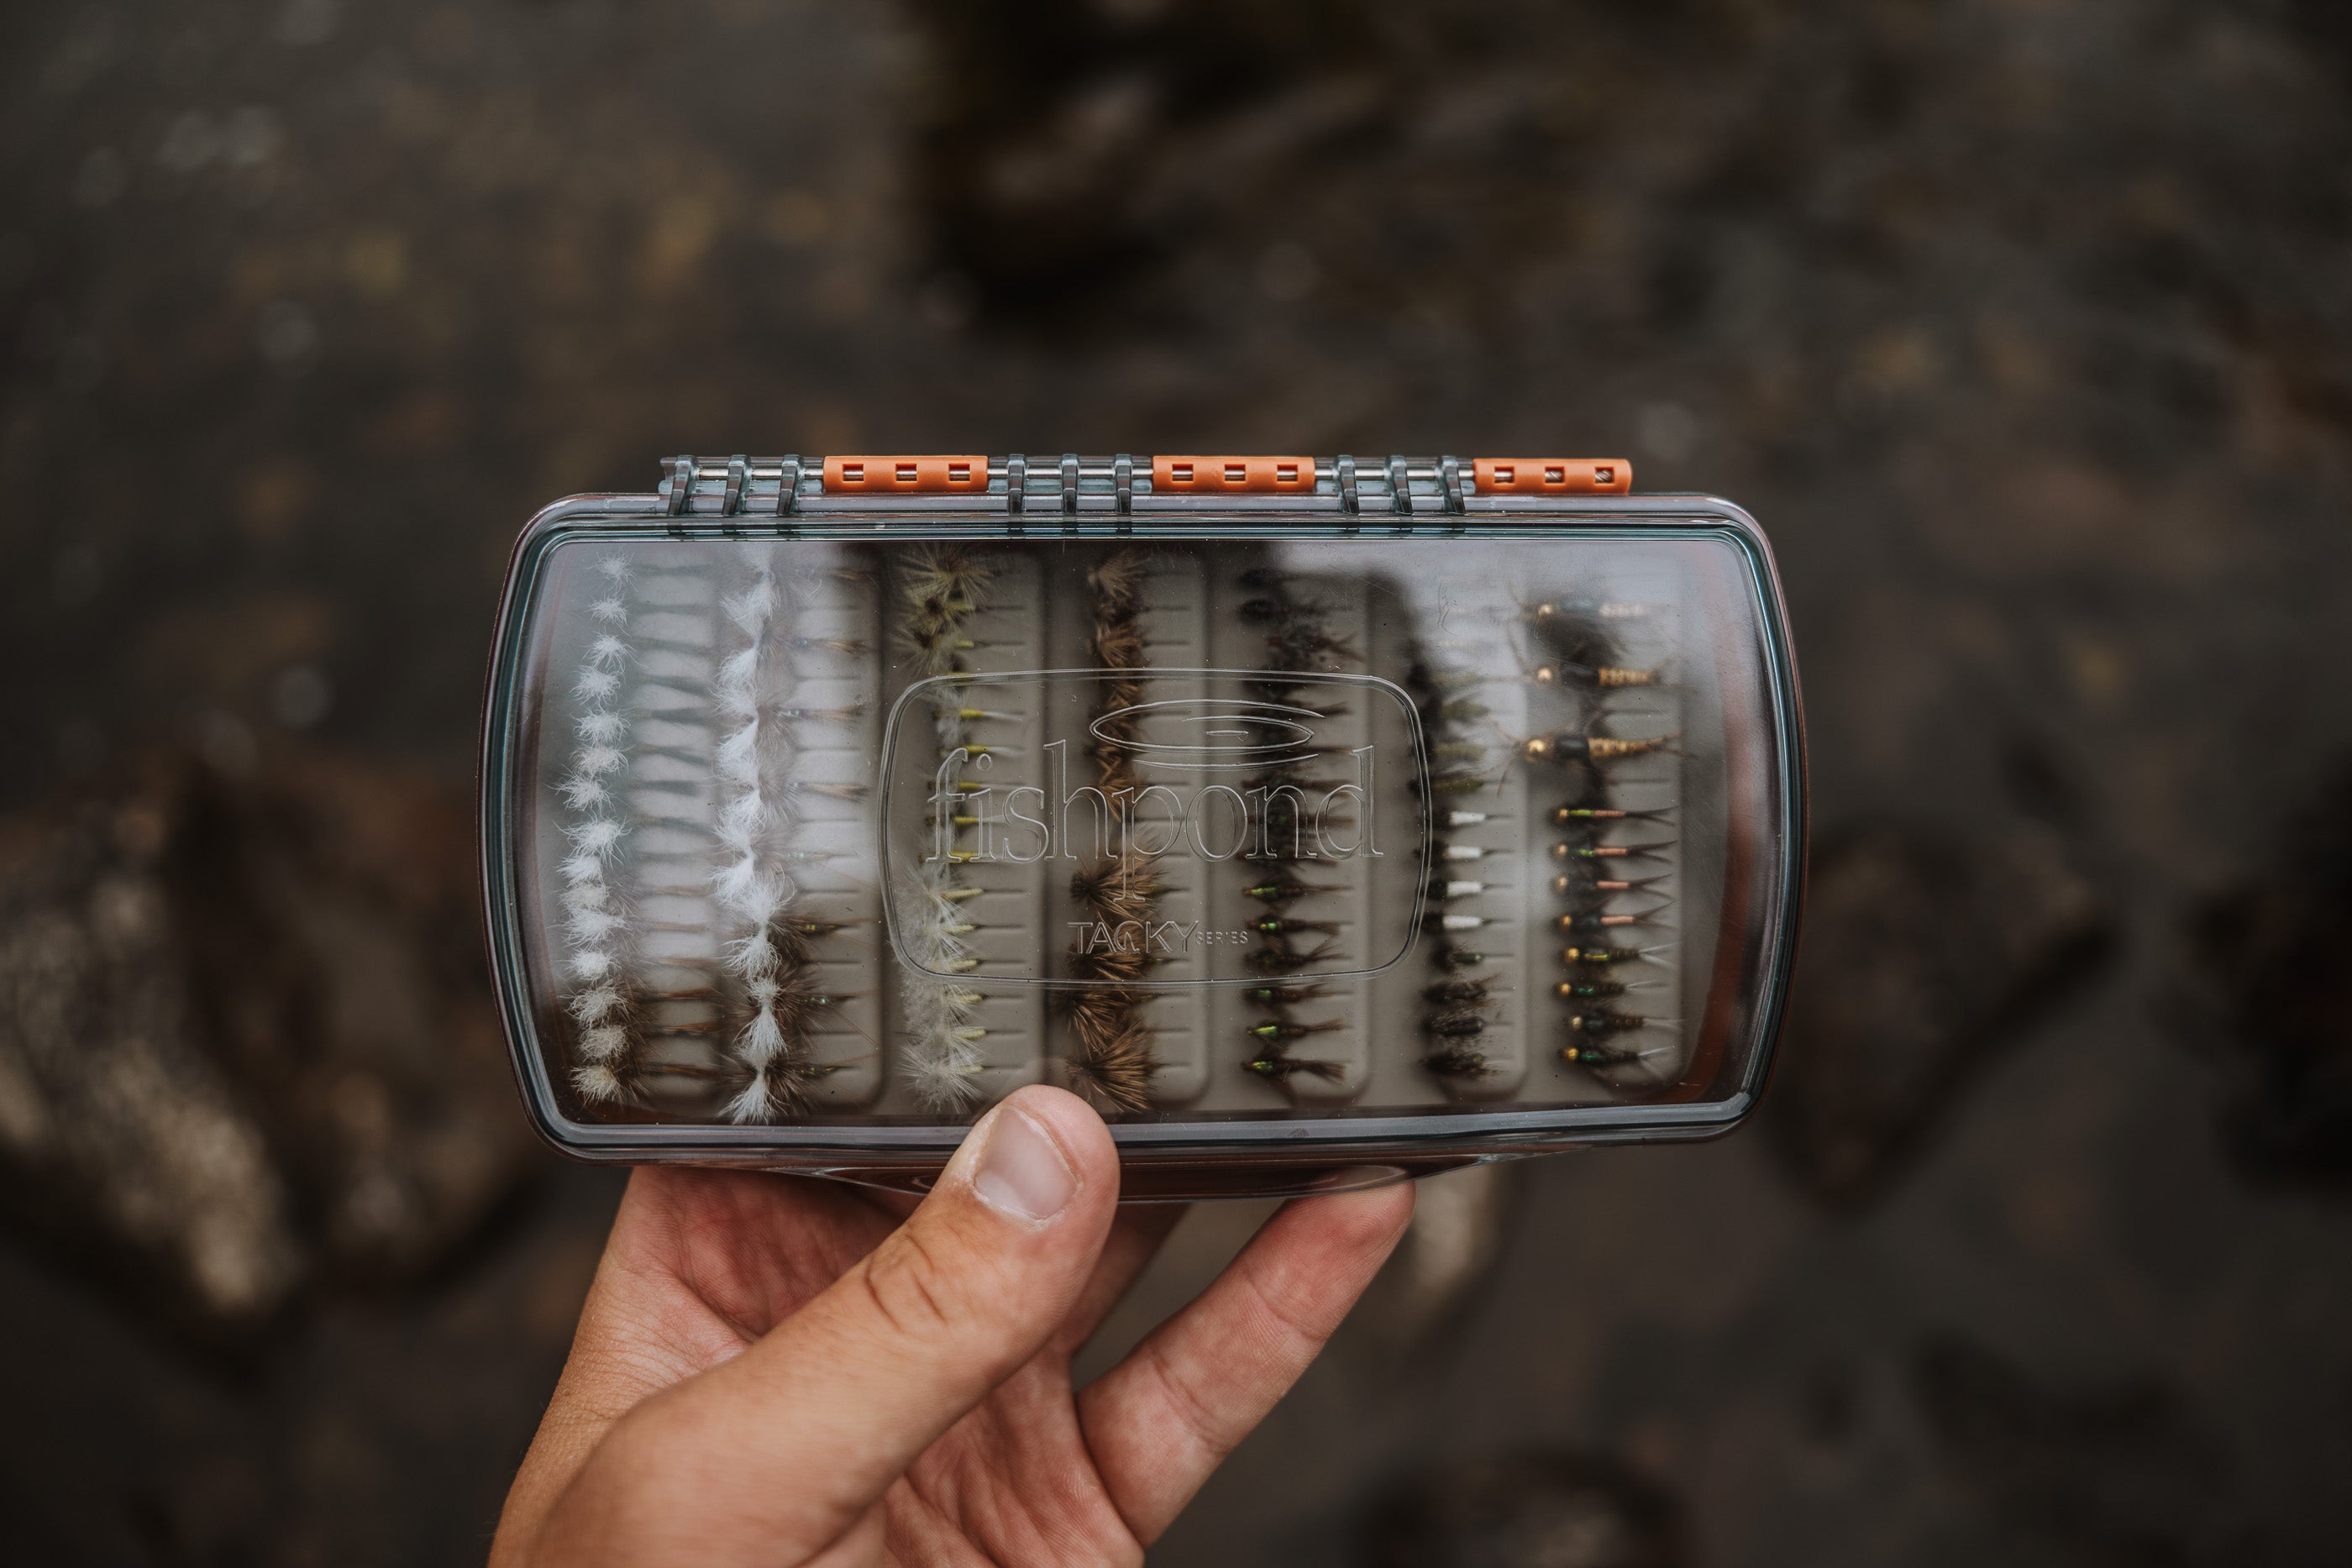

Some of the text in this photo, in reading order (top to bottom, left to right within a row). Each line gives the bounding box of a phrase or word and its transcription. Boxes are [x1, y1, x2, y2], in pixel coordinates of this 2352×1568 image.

[925, 739, 1384, 903] fishpond
[1067, 920, 1249, 954] TACKY SERIES
